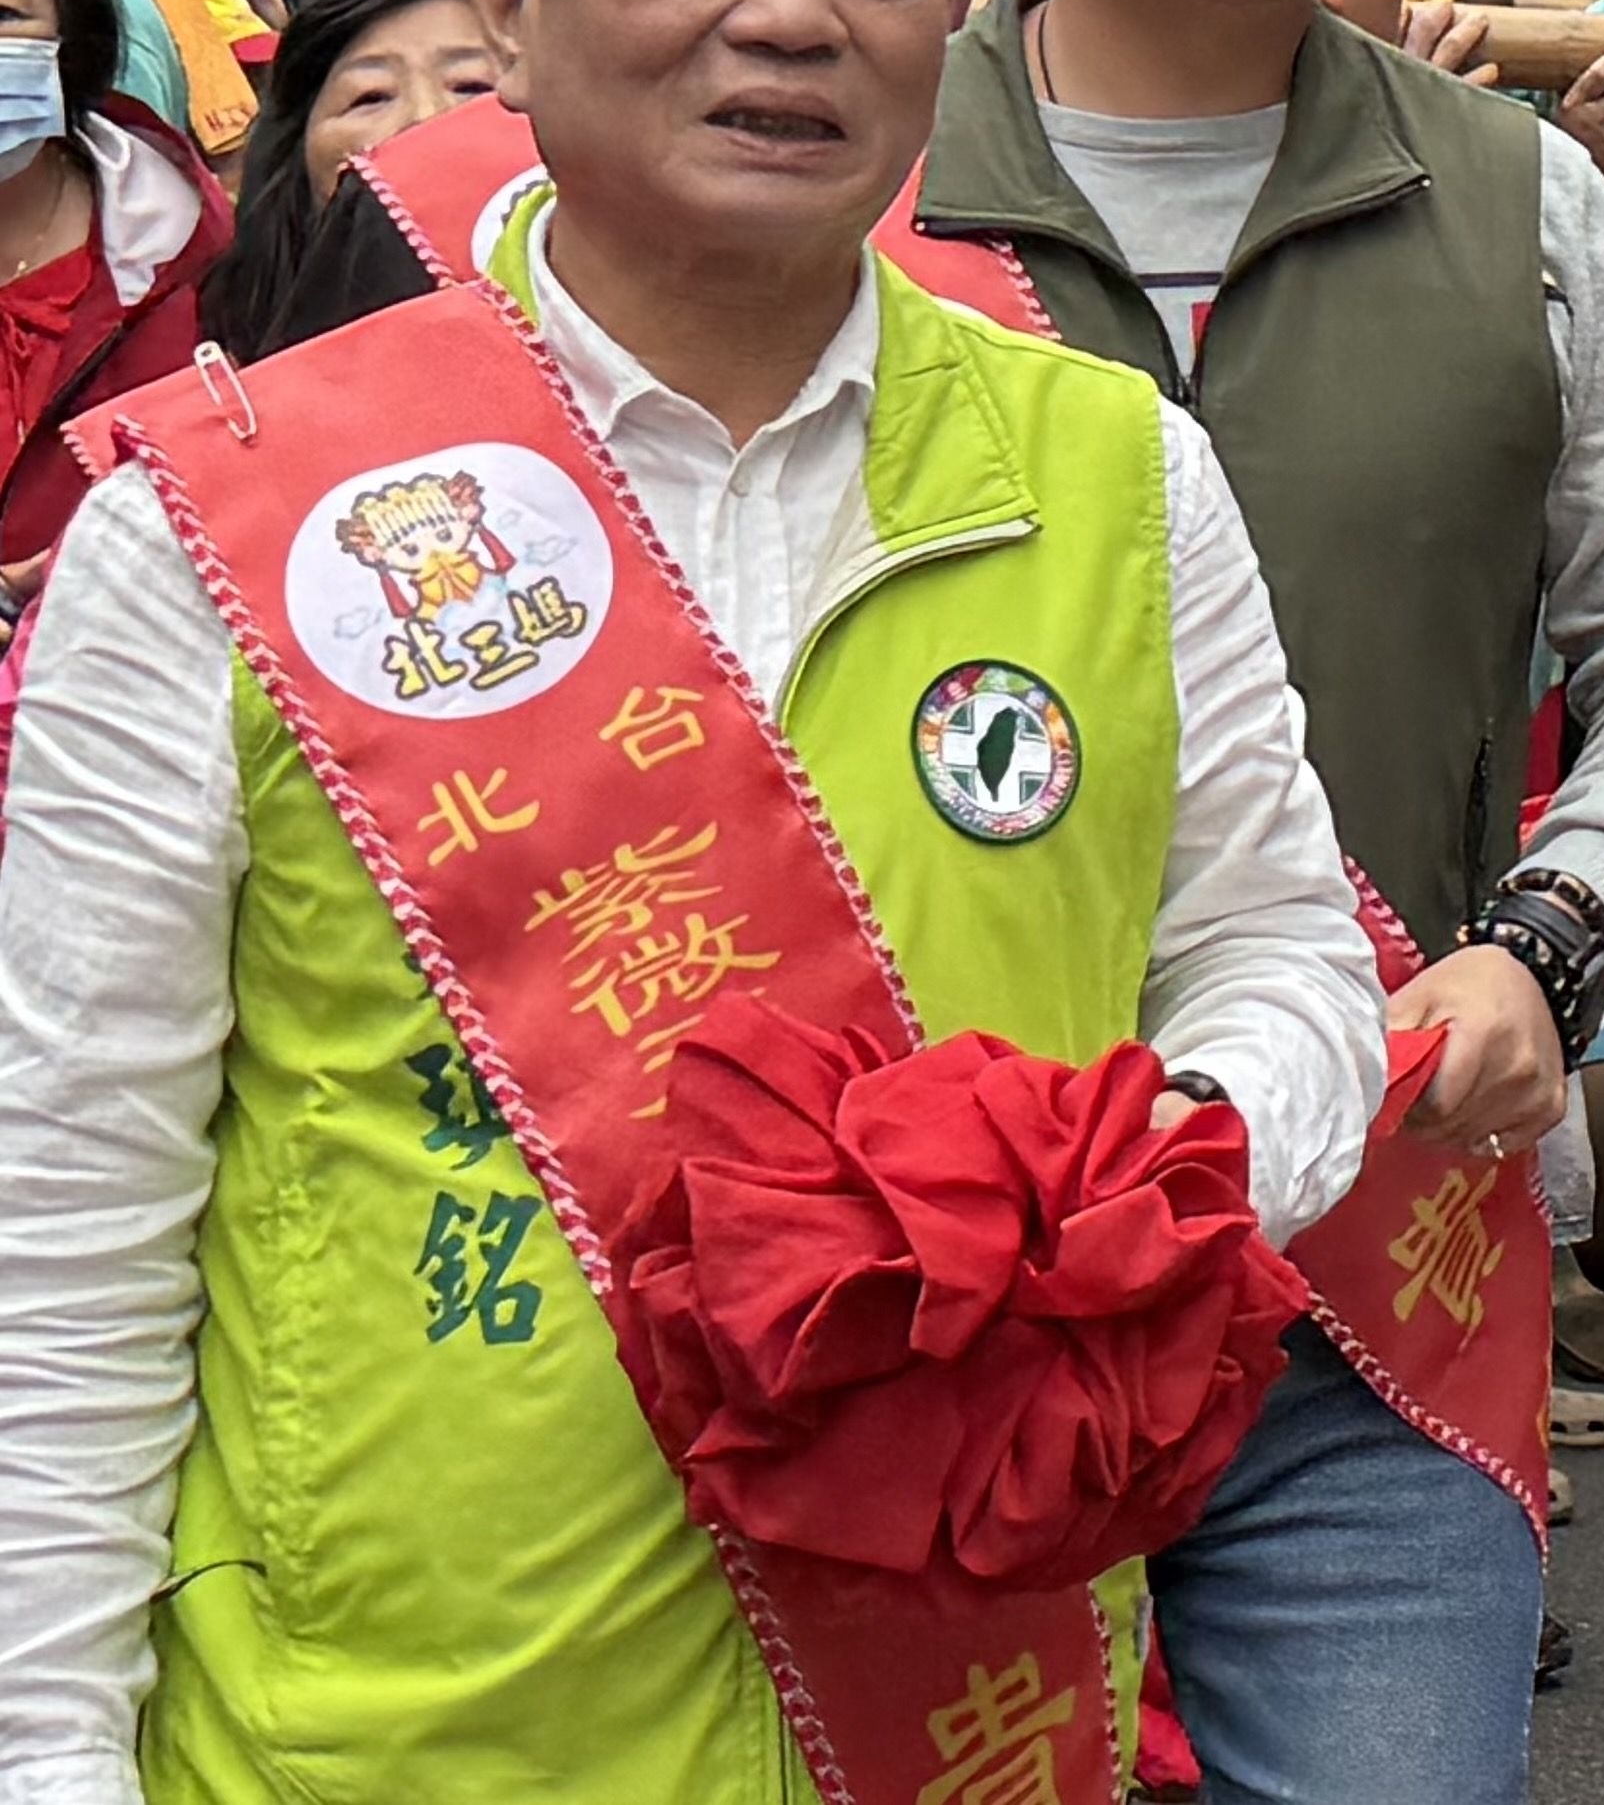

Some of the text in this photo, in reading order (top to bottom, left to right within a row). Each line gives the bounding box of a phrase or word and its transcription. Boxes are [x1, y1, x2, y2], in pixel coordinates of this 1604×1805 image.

[380, 574, 589, 701] 北三媽
[522, 820, 783, 1121] 紫微
